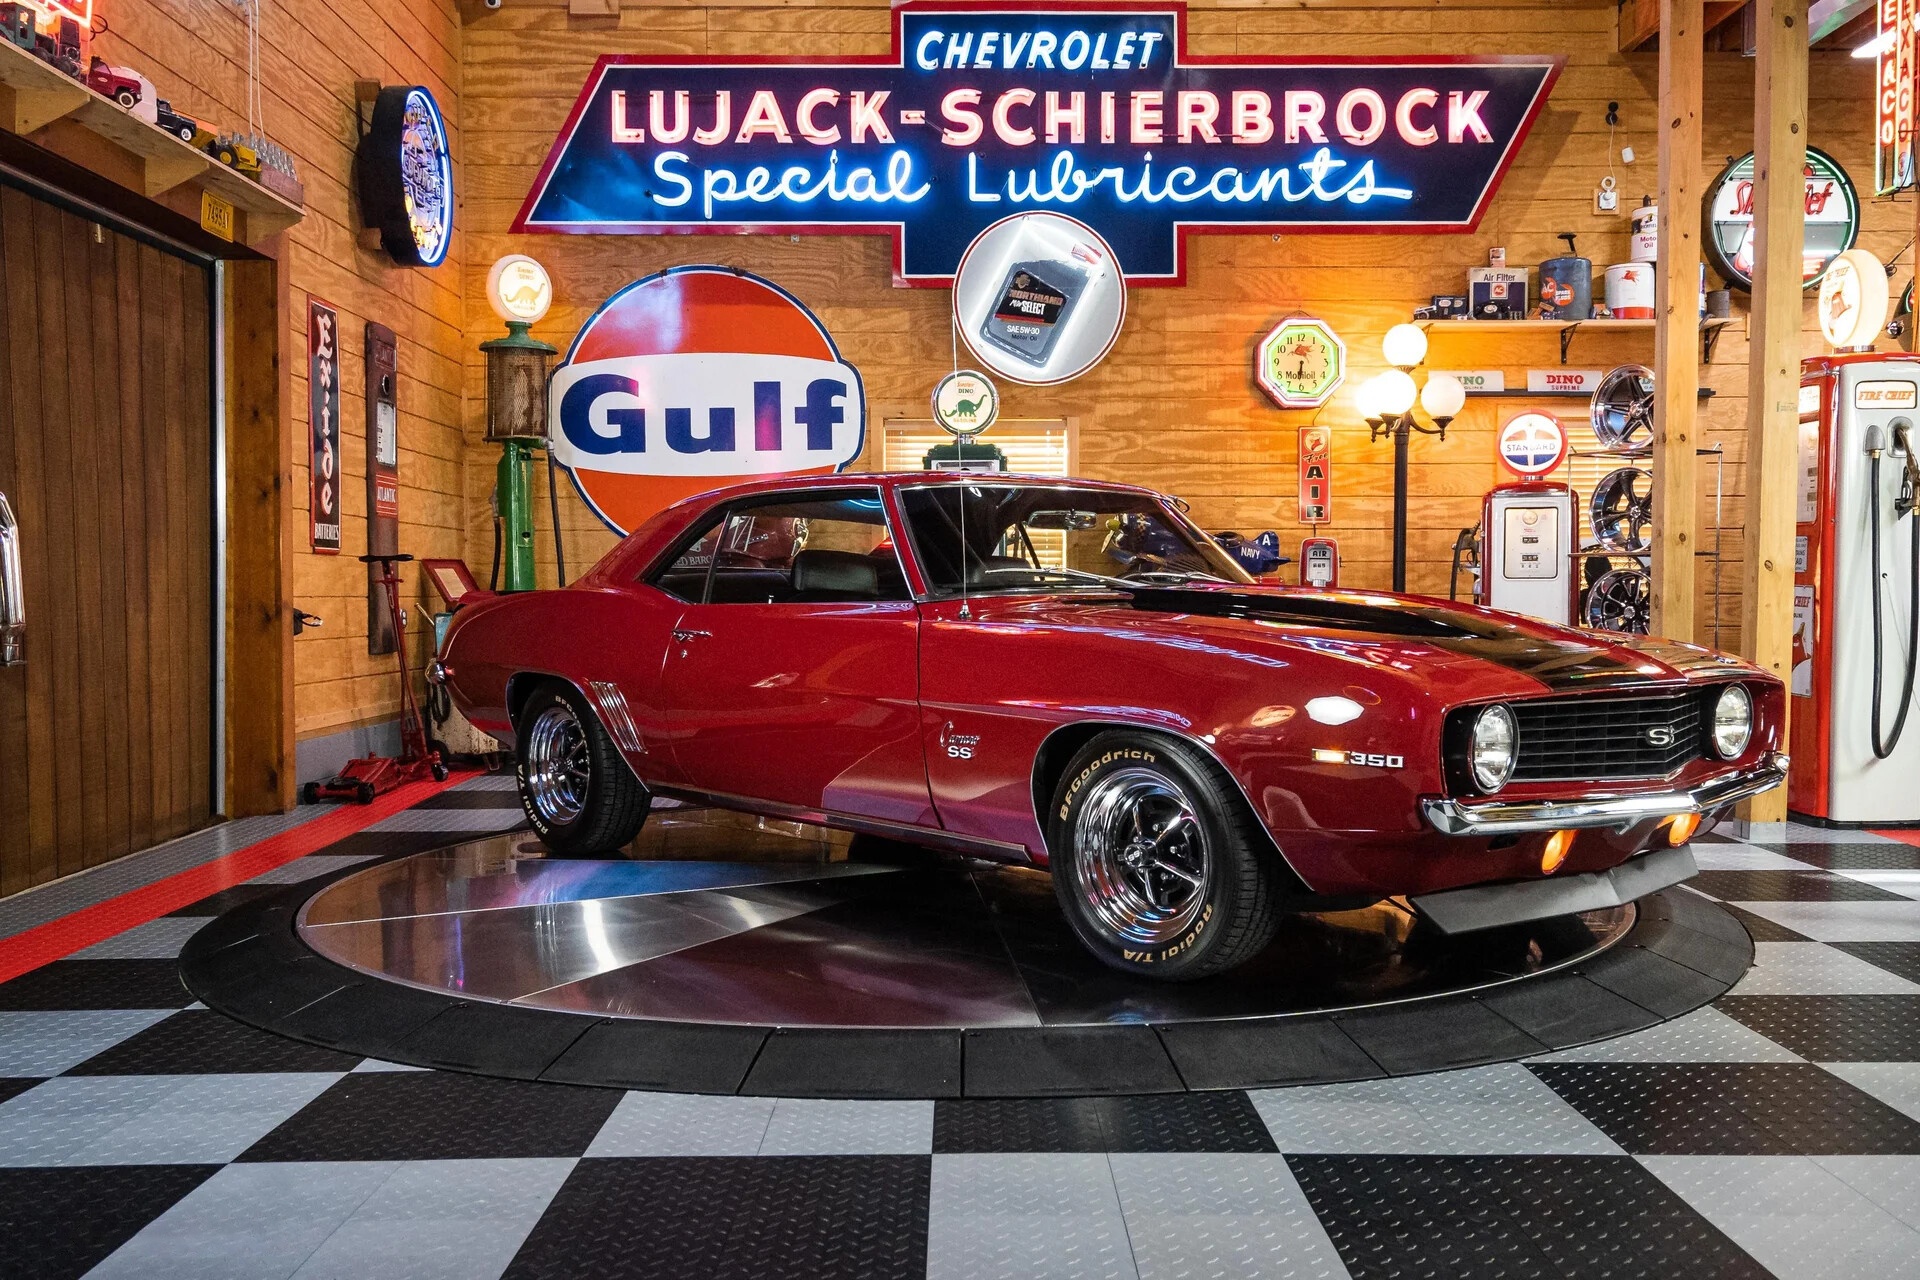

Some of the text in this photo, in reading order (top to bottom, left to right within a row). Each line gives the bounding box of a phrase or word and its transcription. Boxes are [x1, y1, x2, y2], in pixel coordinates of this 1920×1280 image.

[915, 30, 1164, 71] CHEVROLET
[651, 147, 1414, 219] Special Lubricants
[1483, 273, 1516, 282] Air Filter
[1006, 324, 1040, 335] SAE 5W-30
[1286, 337, 1293, 345] 11
[1297, 333, 1306, 342] 12
[1312, 337, 1316, 345] 1
[1277, 345, 1287, 354] 10
[1320, 345, 1326, 354] 2
[1273, 358, 1280, 366] 9
[1323, 358, 1329, 367] 3
[1277, 371, 1283, 380] 8
[1320, 371, 1326, 380] 4
[1456, 375, 1485, 385] INO
[1546, 375, 1585, 385] DINO
[1286, 381, 1292, 389] 7
[1298, 383, 1305, 392] 6
[1312, 380, 1318, 388] 5
[316, 312, 334, 516] Exide
[559, 373, 847, 455] Gulf
[376, 487, 396, 503] ATLANTIC
[314, 522, 340, 541] BATTERIES
[1262, 534, 1271, 546] A
[1240, 546, 1260, 560] NAVY
[947, 745, 972, 759] SS
[1350, 751, 1404, 768] 350
[1059, 748, 1156, 822] BFGoodrich
[1123, 903, 1213, 962] Radial T/A
